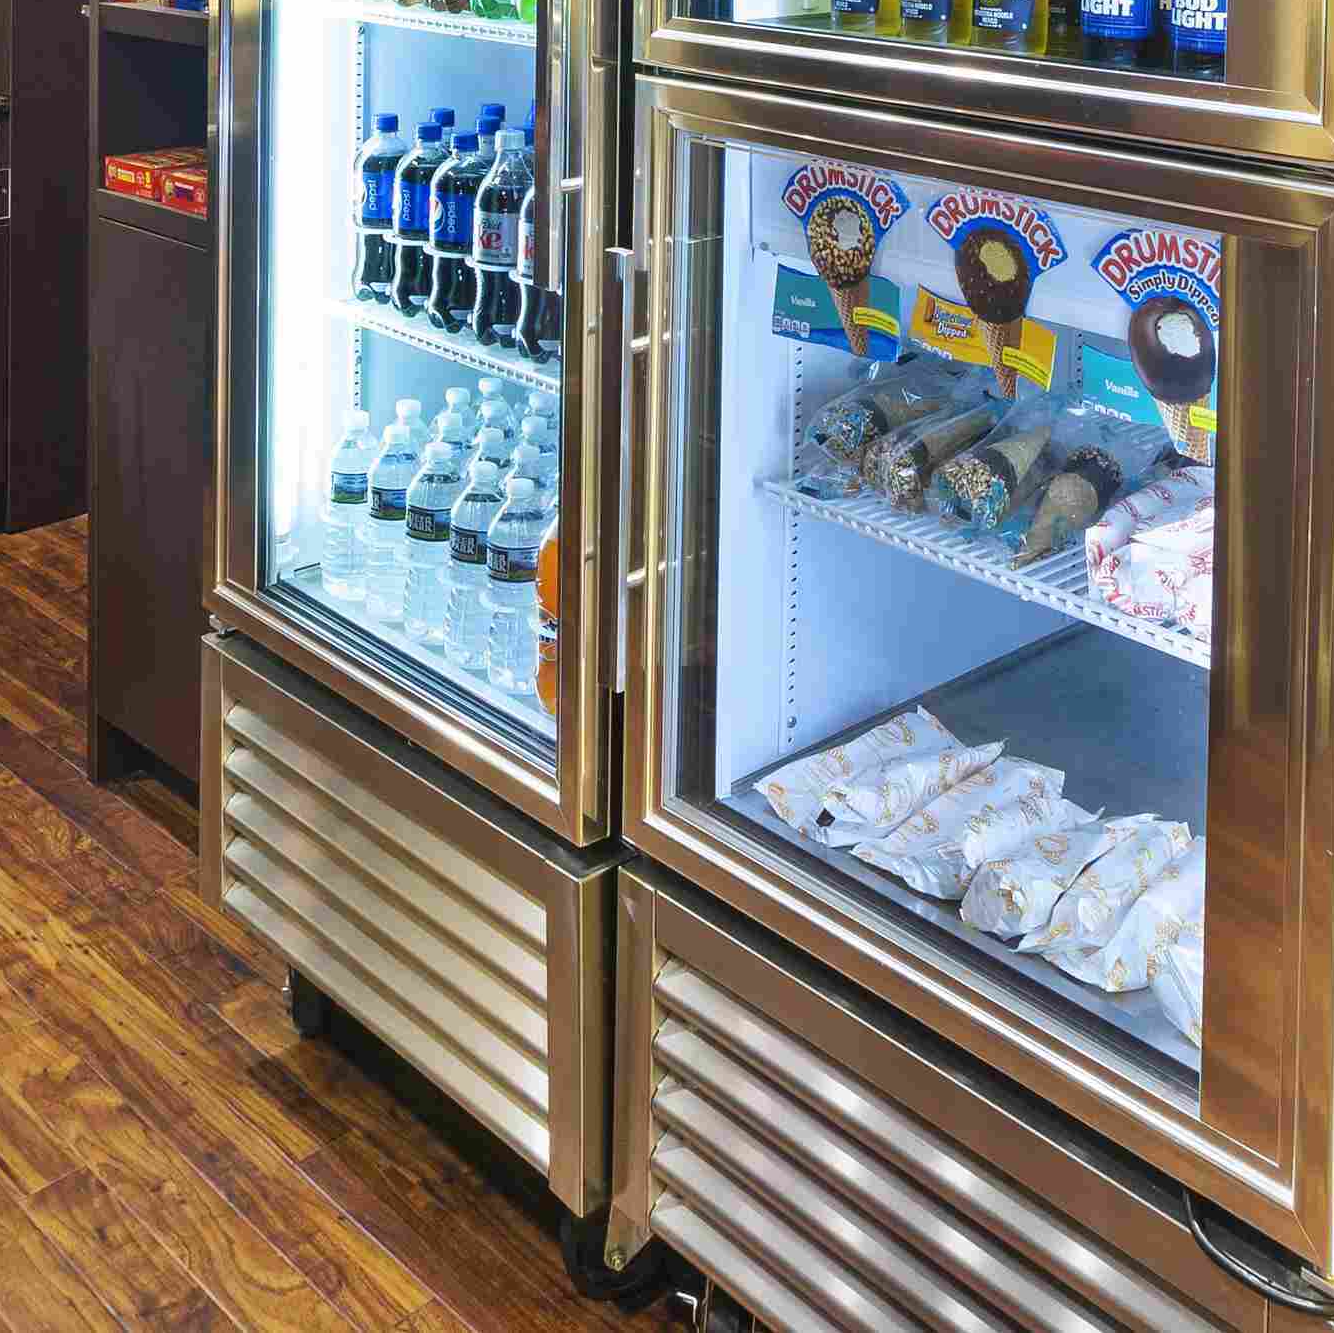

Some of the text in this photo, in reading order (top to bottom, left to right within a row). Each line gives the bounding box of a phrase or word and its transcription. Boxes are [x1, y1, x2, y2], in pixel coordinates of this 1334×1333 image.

[1171, 8, 1227, 31] LIGHT
[783, 164, 903, 230] DRUMSTICK
[446, 200, 457, 235] pepsi
[928, 192, 1063, 271] DRUMSTICK
[1098, 231, 1222, 290] DRUMSTI
[1128, 272, 1176, 301] Simply
[1104, 377, 1141, 399] Vanilla
